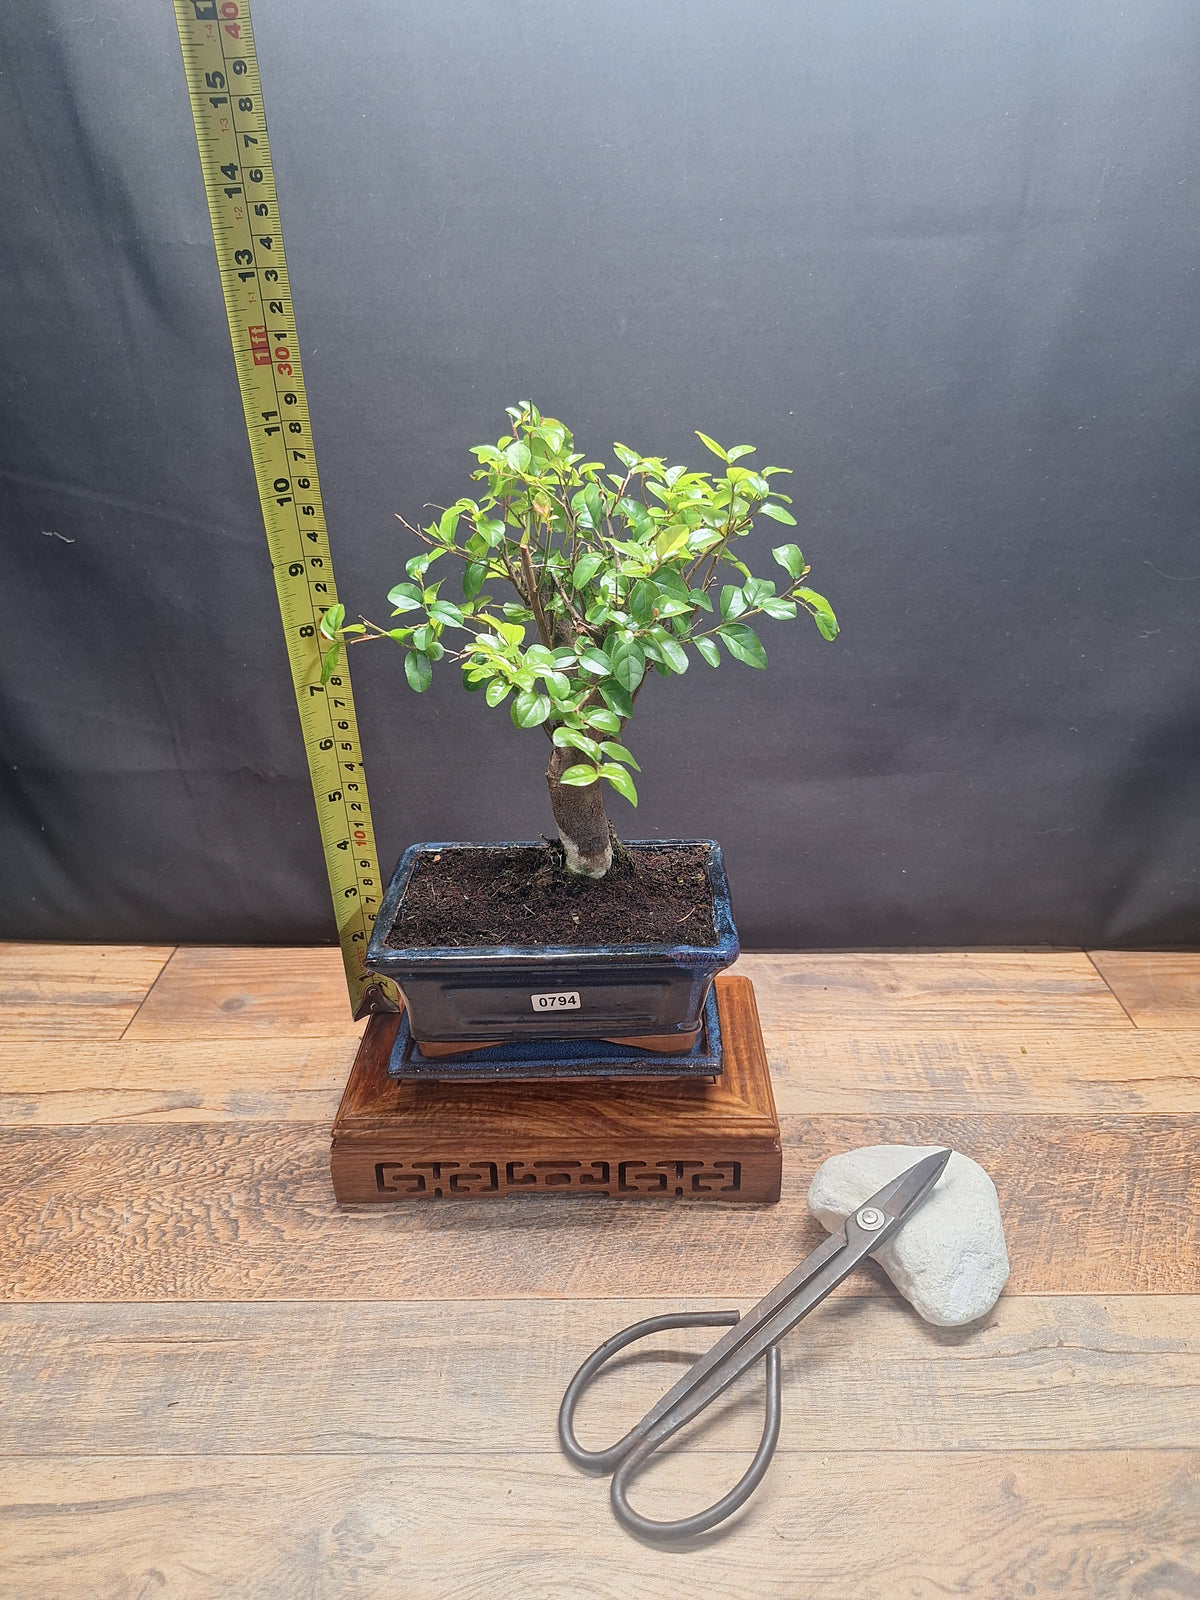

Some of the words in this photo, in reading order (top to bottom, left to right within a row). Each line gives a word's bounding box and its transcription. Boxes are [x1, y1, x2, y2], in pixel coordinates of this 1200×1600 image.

[221, 1, 241, 39] 40
[233, 60, 248, 75] 9
[205, 70, 228, 108] 15
[239, 97, 253, 112] 8
[244, 134, 258, 148] 7
[221, 163, 242, 198] 14
[249, 169, 263, 183] 6
[255, 204, 269, 216] 5
[260, 237, 272, 250] 4
[235, 249, 255, 282] 13
[265, 270, 278, 282] 3
[270, 301, 283, 314] 2
[274, 333, 287, 341] 1
[275, 347, 292, 376] 30
[284, 393, 297, 405] 9
[262, 410, 280, 436] 11
[289, 422, 301, 434] 8
[294, 451, 306, 461] 7
[298, 478, 310, 489] 6
[274, 478, 292, 507] 10
[303, 505, 314, 516] 5
[307, 532, 318, 543] 4
[311, 558, 323, 568] 3
[289, 564, 304, 577] 9
[315, 583, 327, 592] 2
[300, 625, 314, 638] 8
[331, 677, 342, 686] 8
[310, 685, 324, 696] 7
[335, 699, 345, 708] 7
[338, 721, 349, 730] 6
[320, 739, 333, 750] 6
[342, 743, 352, 751] 5
[345, 763, 355, 771] 4
[348, 783, 358, 791] 3
[329, 791, 342, 802] 5
[351, 803, 361, 811] 2
[354, 831, 366, 846] 10
[337, 840, 349, 851] 4
[360, 860, 370, 868] 9
[363, 878, 373, 886] 8
[344, 888, 357, 898] 3
[368, 914, 377, 922] 6
[352, 932, 364, 942] 2
[538, 995, 577, 1007] 0794
